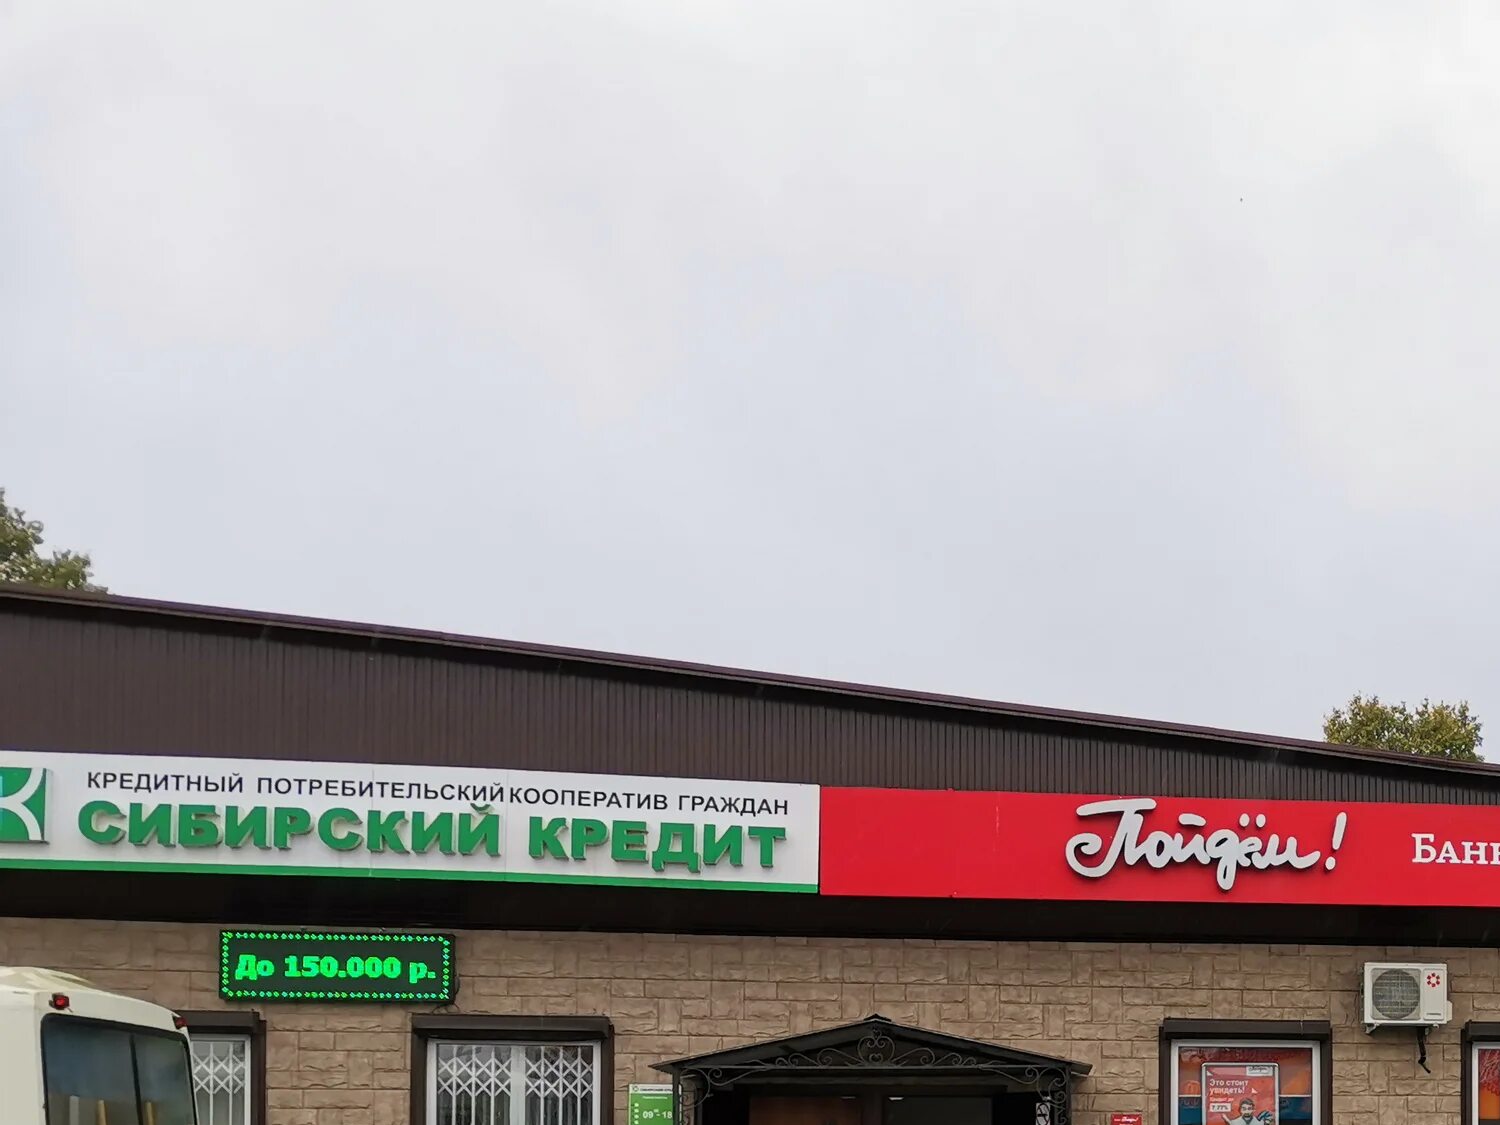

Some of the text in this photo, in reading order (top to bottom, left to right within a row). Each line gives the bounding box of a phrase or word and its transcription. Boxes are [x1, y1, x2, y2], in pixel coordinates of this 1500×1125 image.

[87, 772, 788, 816] КРЕДИТНЫЙ ПОТРЕБИТЕЛЬСКИЙ КООПЕРАТИВ ГРАЖДАН
[78, 800, 786, 873] СИБИРСКИЙ КРЕДИТ
[1065, 797, 1347, 891] Пойдём!
[235, 954, 436, 984] До 150.000 р.
[1210, 1079, 1225, 1087] Это
